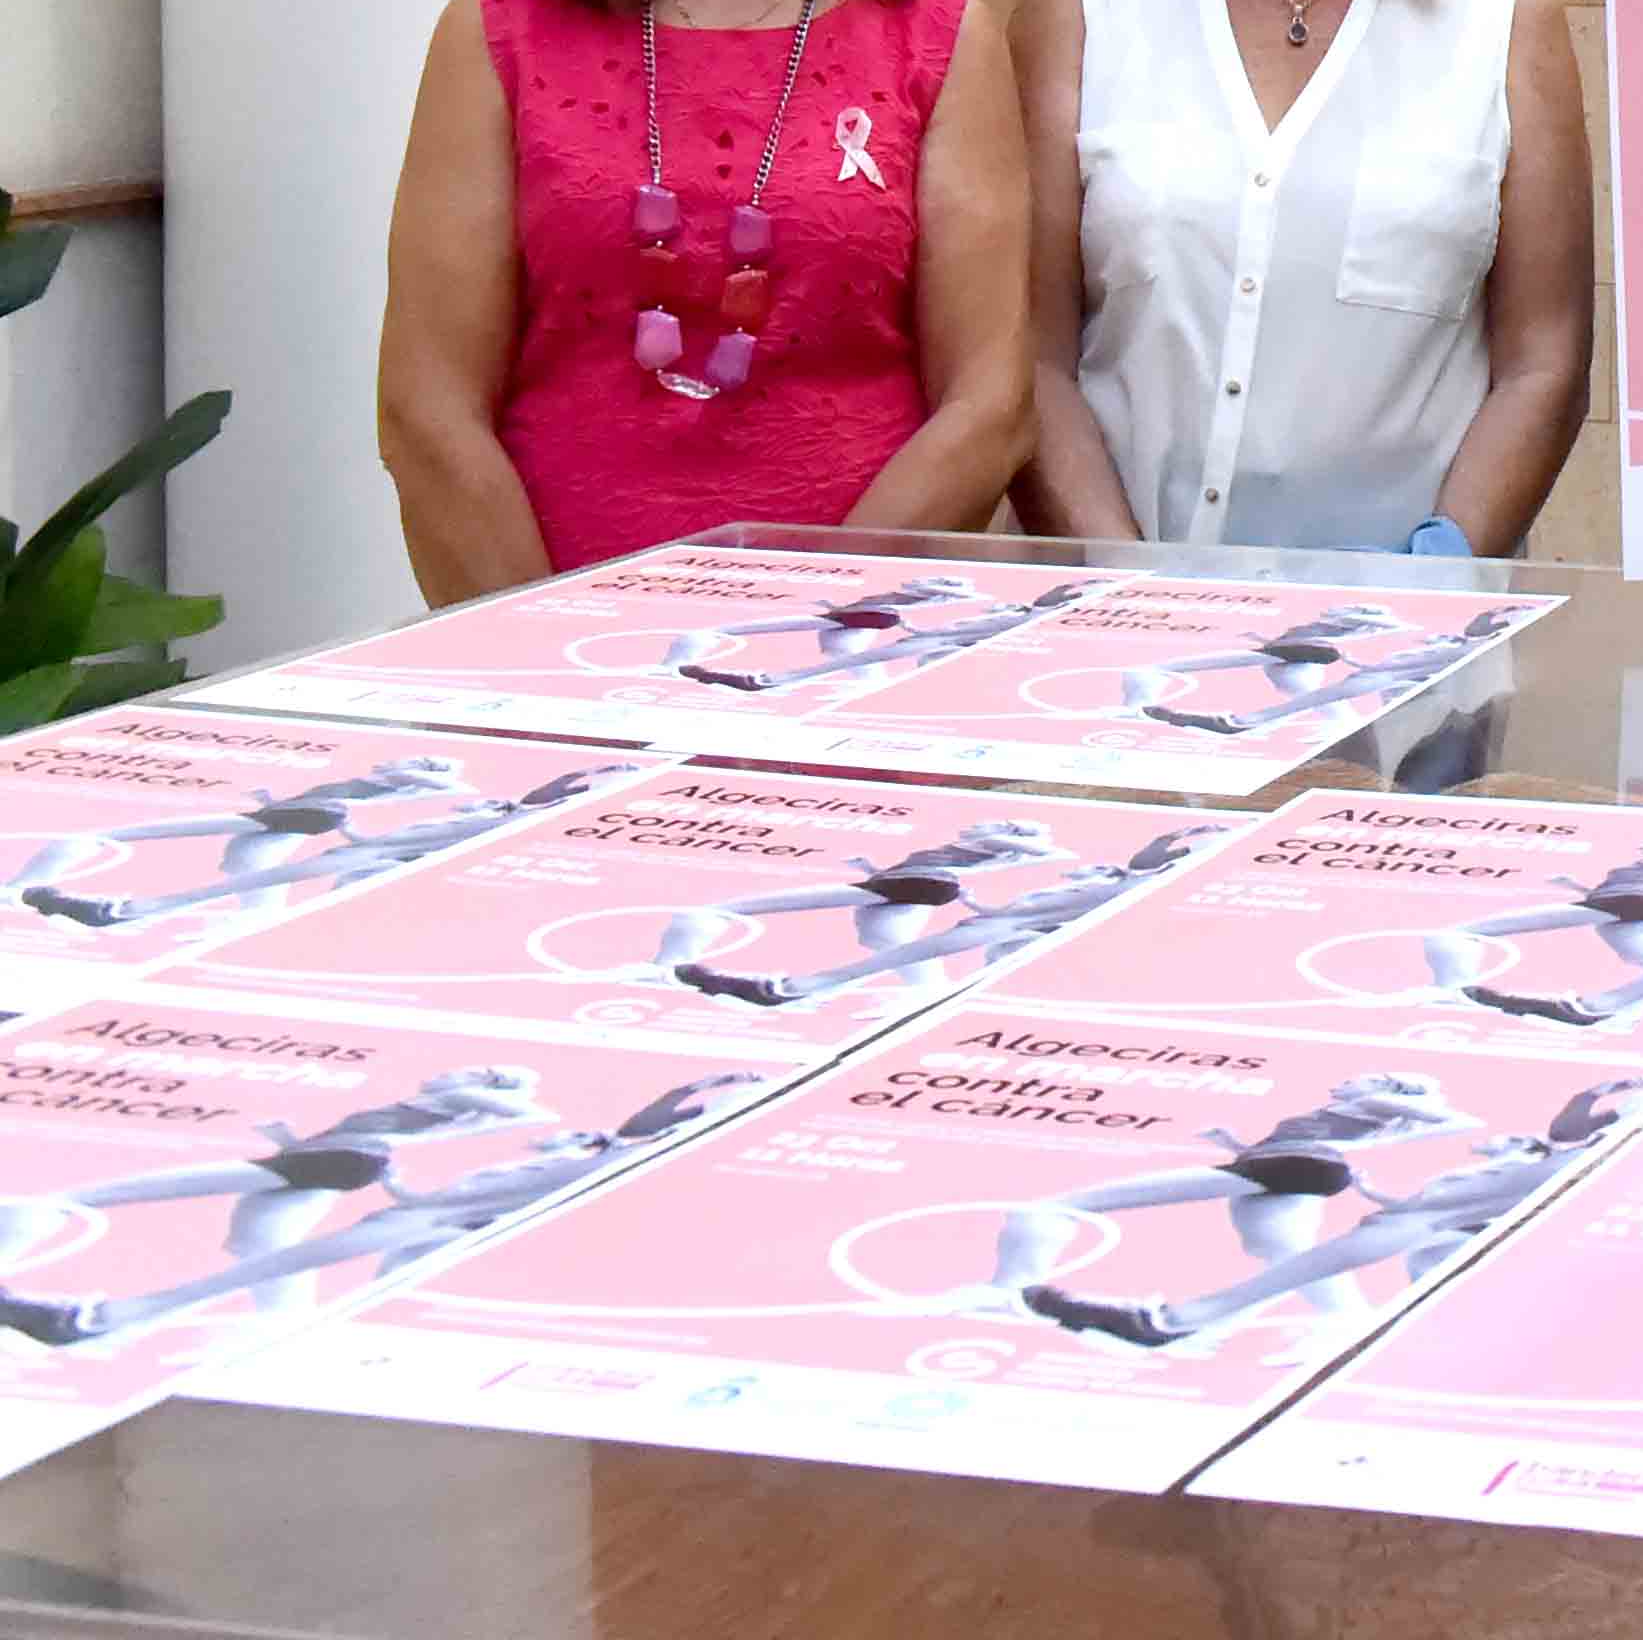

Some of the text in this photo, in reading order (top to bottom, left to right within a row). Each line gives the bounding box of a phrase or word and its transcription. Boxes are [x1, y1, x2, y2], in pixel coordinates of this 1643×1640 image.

[659, 783, 915, 817] Algeciras
[564, 826, 625, 840] el
[598, 812, 774, 838] contra
[1320, 807, 1580, 836] Algeciras
[1253, 851, 1307, 866] el
[1276, 838, 1456, 860] contra
[64, 1019, 377, 1062] Algeciras
[954, 1031, 1268, 1072] Algeciras
[848, 1089, 923, 1109] el
[887, 1071, 1105, 1103] contra
